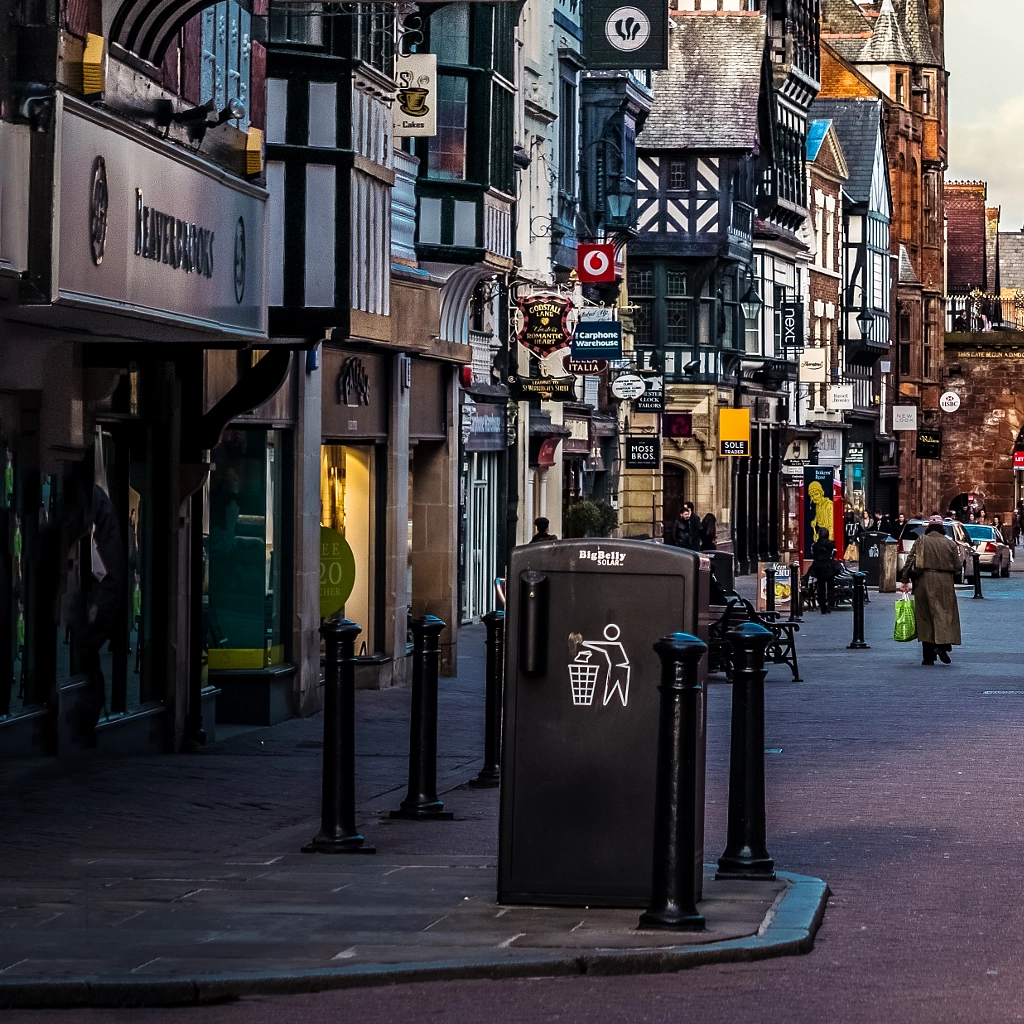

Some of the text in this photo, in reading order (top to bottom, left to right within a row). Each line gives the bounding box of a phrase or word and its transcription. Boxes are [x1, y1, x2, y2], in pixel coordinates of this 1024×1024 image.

[402, 120, 425, 129] Cakes
[785, 308, 796, 343] next
[579, 332, 619, 340] Carphone
[568, 364, 599, 372] ITALIA
[631, 445, 654, 453] MOSS
[724, 441, 744, 449] SOLE
[631, 452, 656, 460] BROS.
[321, 542, 340, 556] EE
[579, 550, 627, 562] BigBelly
[319, 562, 343, 585] 20
[774, 569, 790, 577] ENU
